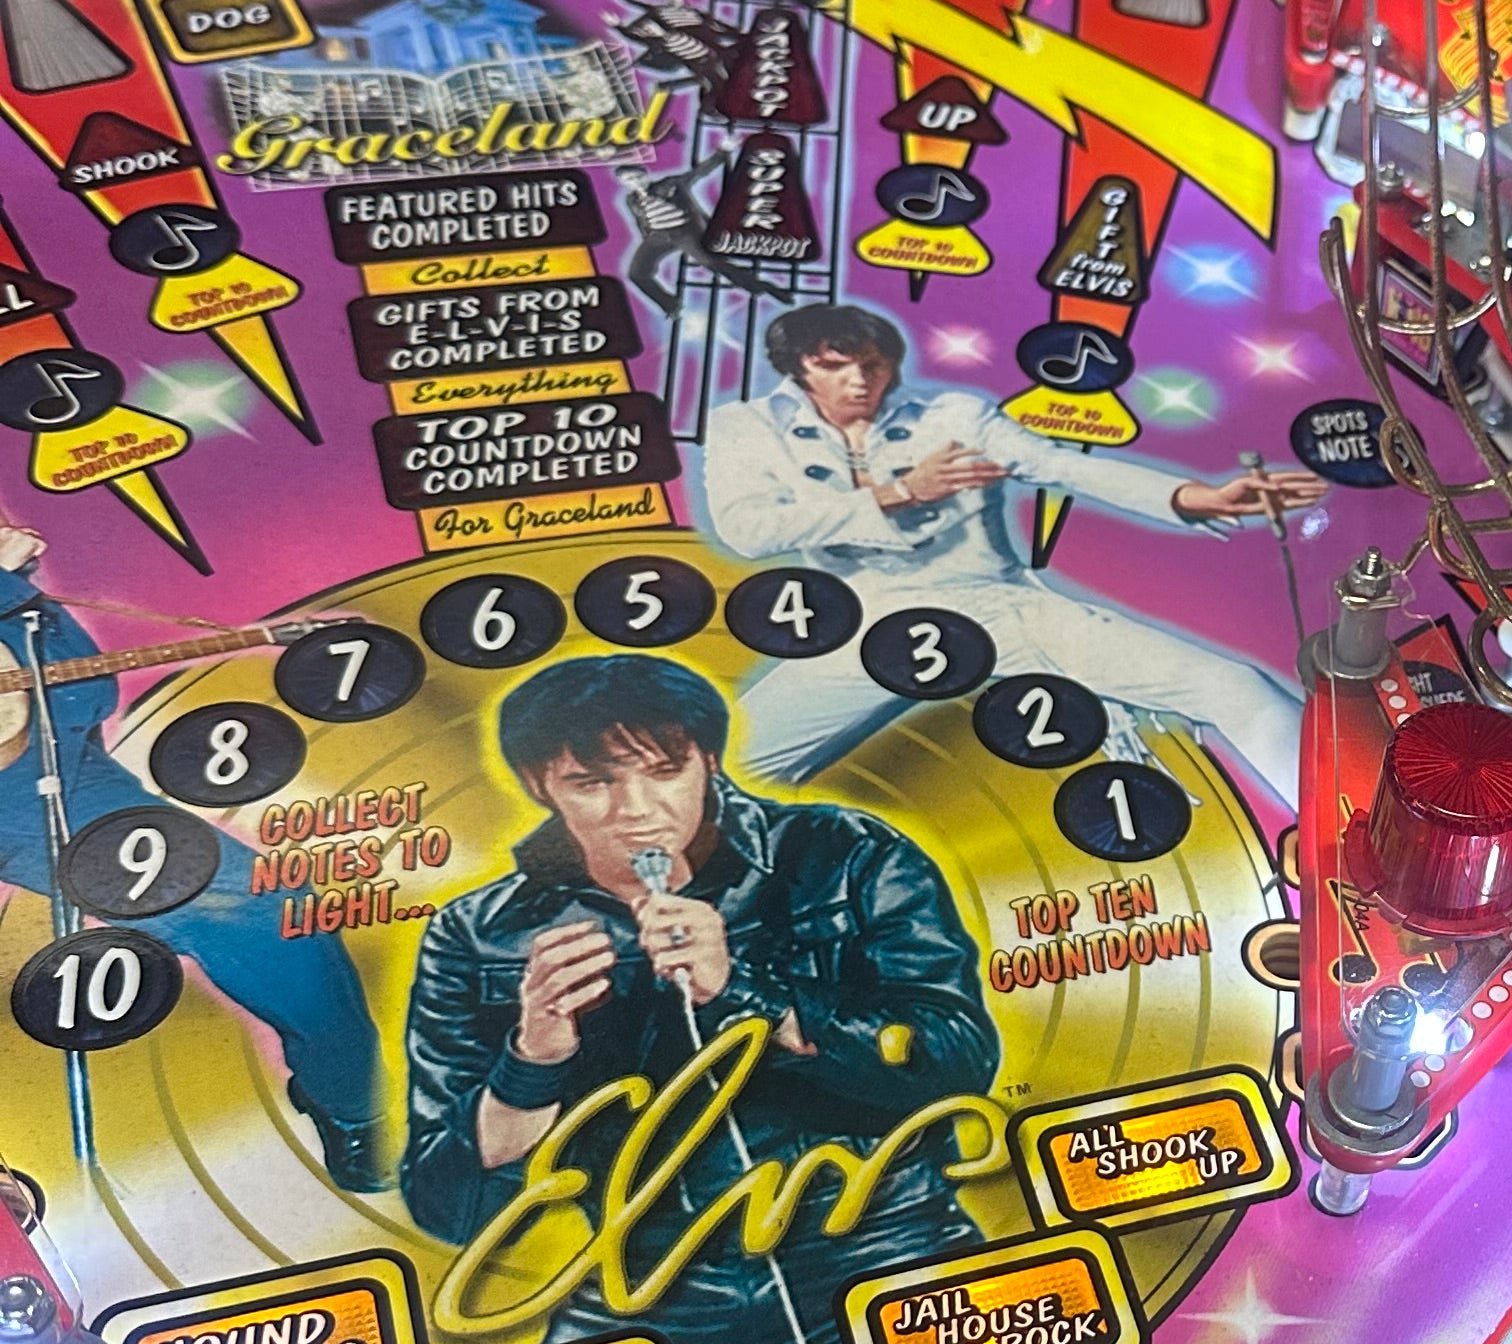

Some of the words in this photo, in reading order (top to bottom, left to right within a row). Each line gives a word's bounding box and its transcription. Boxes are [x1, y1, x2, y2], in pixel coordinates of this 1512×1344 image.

[187, 3, 271, 33] DOG
[752, 16, 793, 117] JACKPOT
[216, 89, 674, 176] Graceland
[916, 101, 978, 132] UP
[71, 147, 181, 184] SHOOK
[343, 186, 498, 223] FEATURED
[511, 180, 578, 207] HITS
[743, 147, 786, 231] SUPER
[372, 210, 551, 250] COMPLETED
[1098, 187, 1130, 257] GIFT
[711, 232, 811, 258] JACKPOT
[866, 245, 980, 269] COUNTDOWN
[1071, 250, 1126, 276] from
[411, 254, 550, 285] Collect
[1055, 270, 1134, 297] ELVIS
[170, 285, 289, 327] COUNTDOWN
[188, 286, 224, 306] TOP
[378, 296, 480, 325] GIFTS
[499, 285, 600, 313] FROM
[408, 310, 582, 345] E-L-V-I-S
[389, 332, 607, 371] COMPLETED
[411, 370, 618, 404] Everything
[418, 412, 526, 444] TOP
[554, 403, 618, 430] 10
[1019, 411, 1126, 439] COUNTDOWN
[1045, 402, 1080, 419] TOP
[1311, 410, 1368, 435] SPOTS
[52, 434, 178, 487] COUNTDOWN
[69, 440, 110, 462] TOP
[407, 425, 642, 471] COUNTDOWN
[1318, 438, 1373, 463] NOTE
[425, 451, 639, 495] COMPLETED
[434, 509, 492, 539] For
[504, 488, 656, 538] Graceland
[472, 588, 516, 651] 6
[625, 571, 663, 631] 5
[769, 580, 814, 639] 4
[329, 640, 370, 701] 7
[907, 621, 947, 683] 3
[1017, 687, 1065, 748] 2
[205, 719, 249, 785] 8
[259, 782, 427, 846] COLLECT
[1105, 778, 1136, 841] 1
[119, 827, 166, 901] 9
[249, 839, 382, 895] NOTES
[399, 826, 451, 871] TO
[280, 884, 436, 939] LIGHT...
[1010, 888, 1080, 938] TOP
[1094, 875, 1157, 920] TEN
[990, 912, 1210, 992] COUNTDOWN
[54, 947, 141, 1029] 10
[1069, 1125, 1126, 1160] ALL
[1097, 1129, 1210, 1176] SHOOK
[432, 1016, 1013, 1336] Elvis
[1199, 1149, 1239, 1180] UP
[895, 1289, 971, 1330] JAIL
